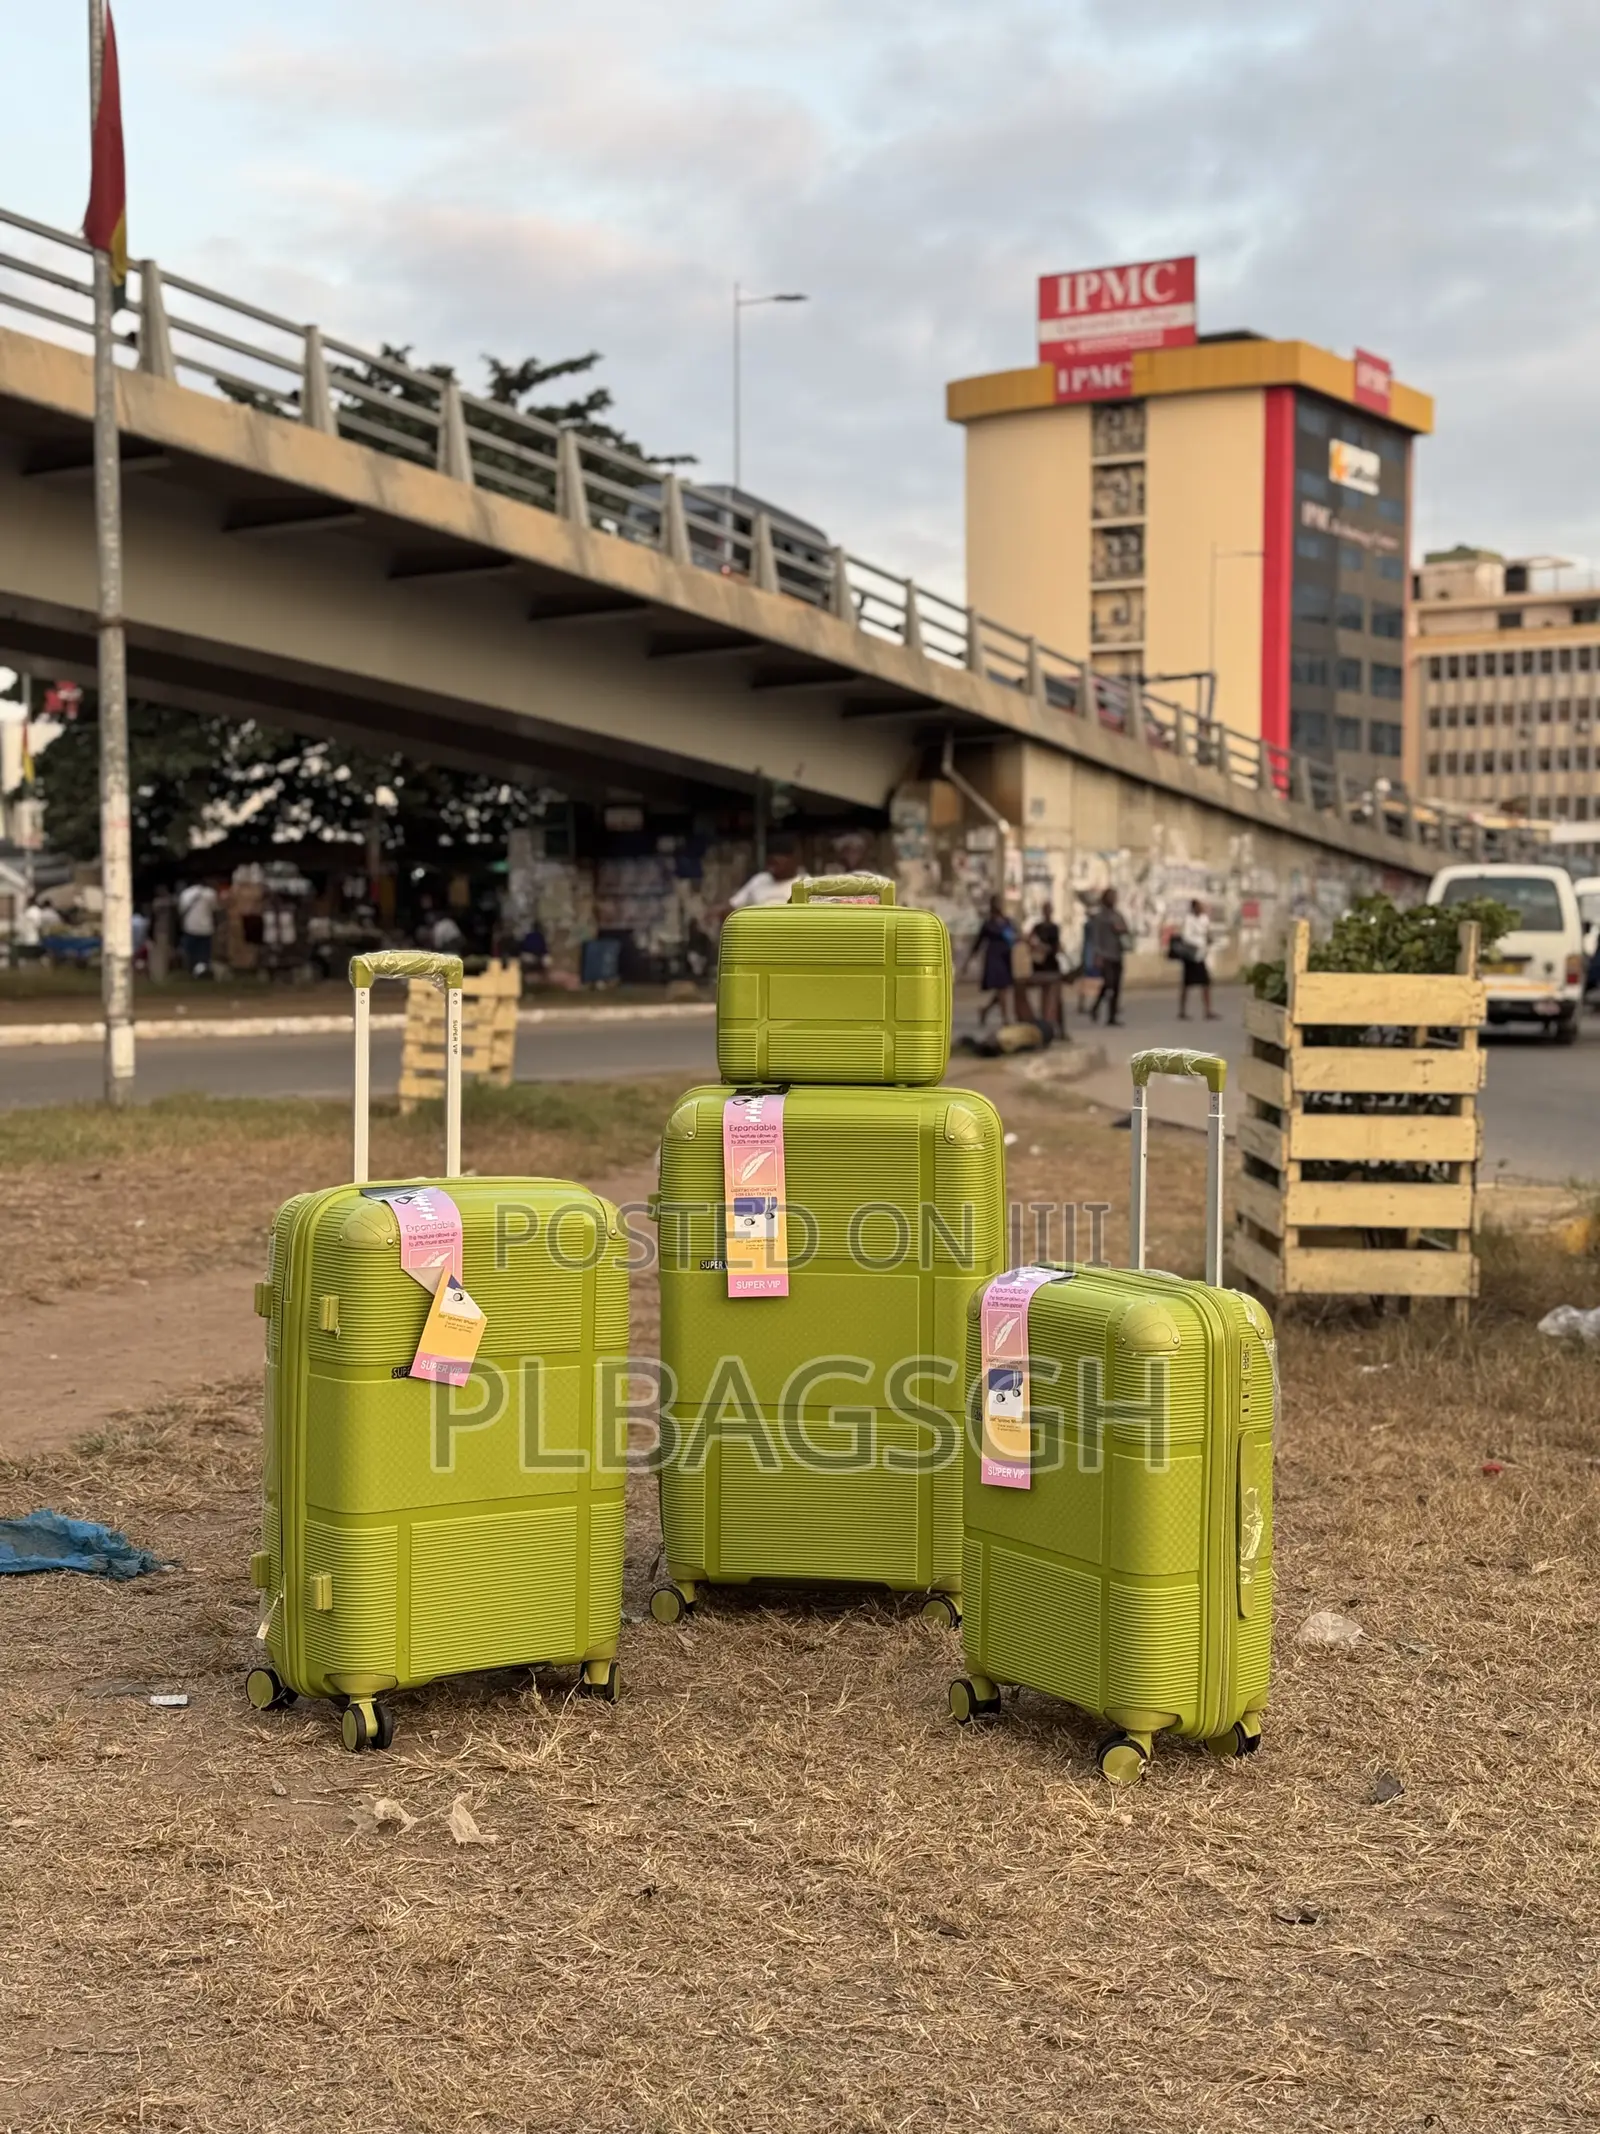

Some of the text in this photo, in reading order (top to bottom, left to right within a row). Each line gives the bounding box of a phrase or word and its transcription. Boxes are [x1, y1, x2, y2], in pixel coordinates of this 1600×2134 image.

[1057, 262, 1177, 314] IPMC
[1058, 361, 1133, 394] IPMC
[729, 1124, 777, 1132] Expandable
[405, 1221, 456, 1233] Expandable
[701, 1260, 723, 1270] SUPER
[736, 1280, 781, 1290] SUPER VIP
[989, 1286, 1030, 1295] Expandable
[420, 1360, 463, 1377] SUPER VIP
[987, 1466, 1025, 1479] SUPER VIP
